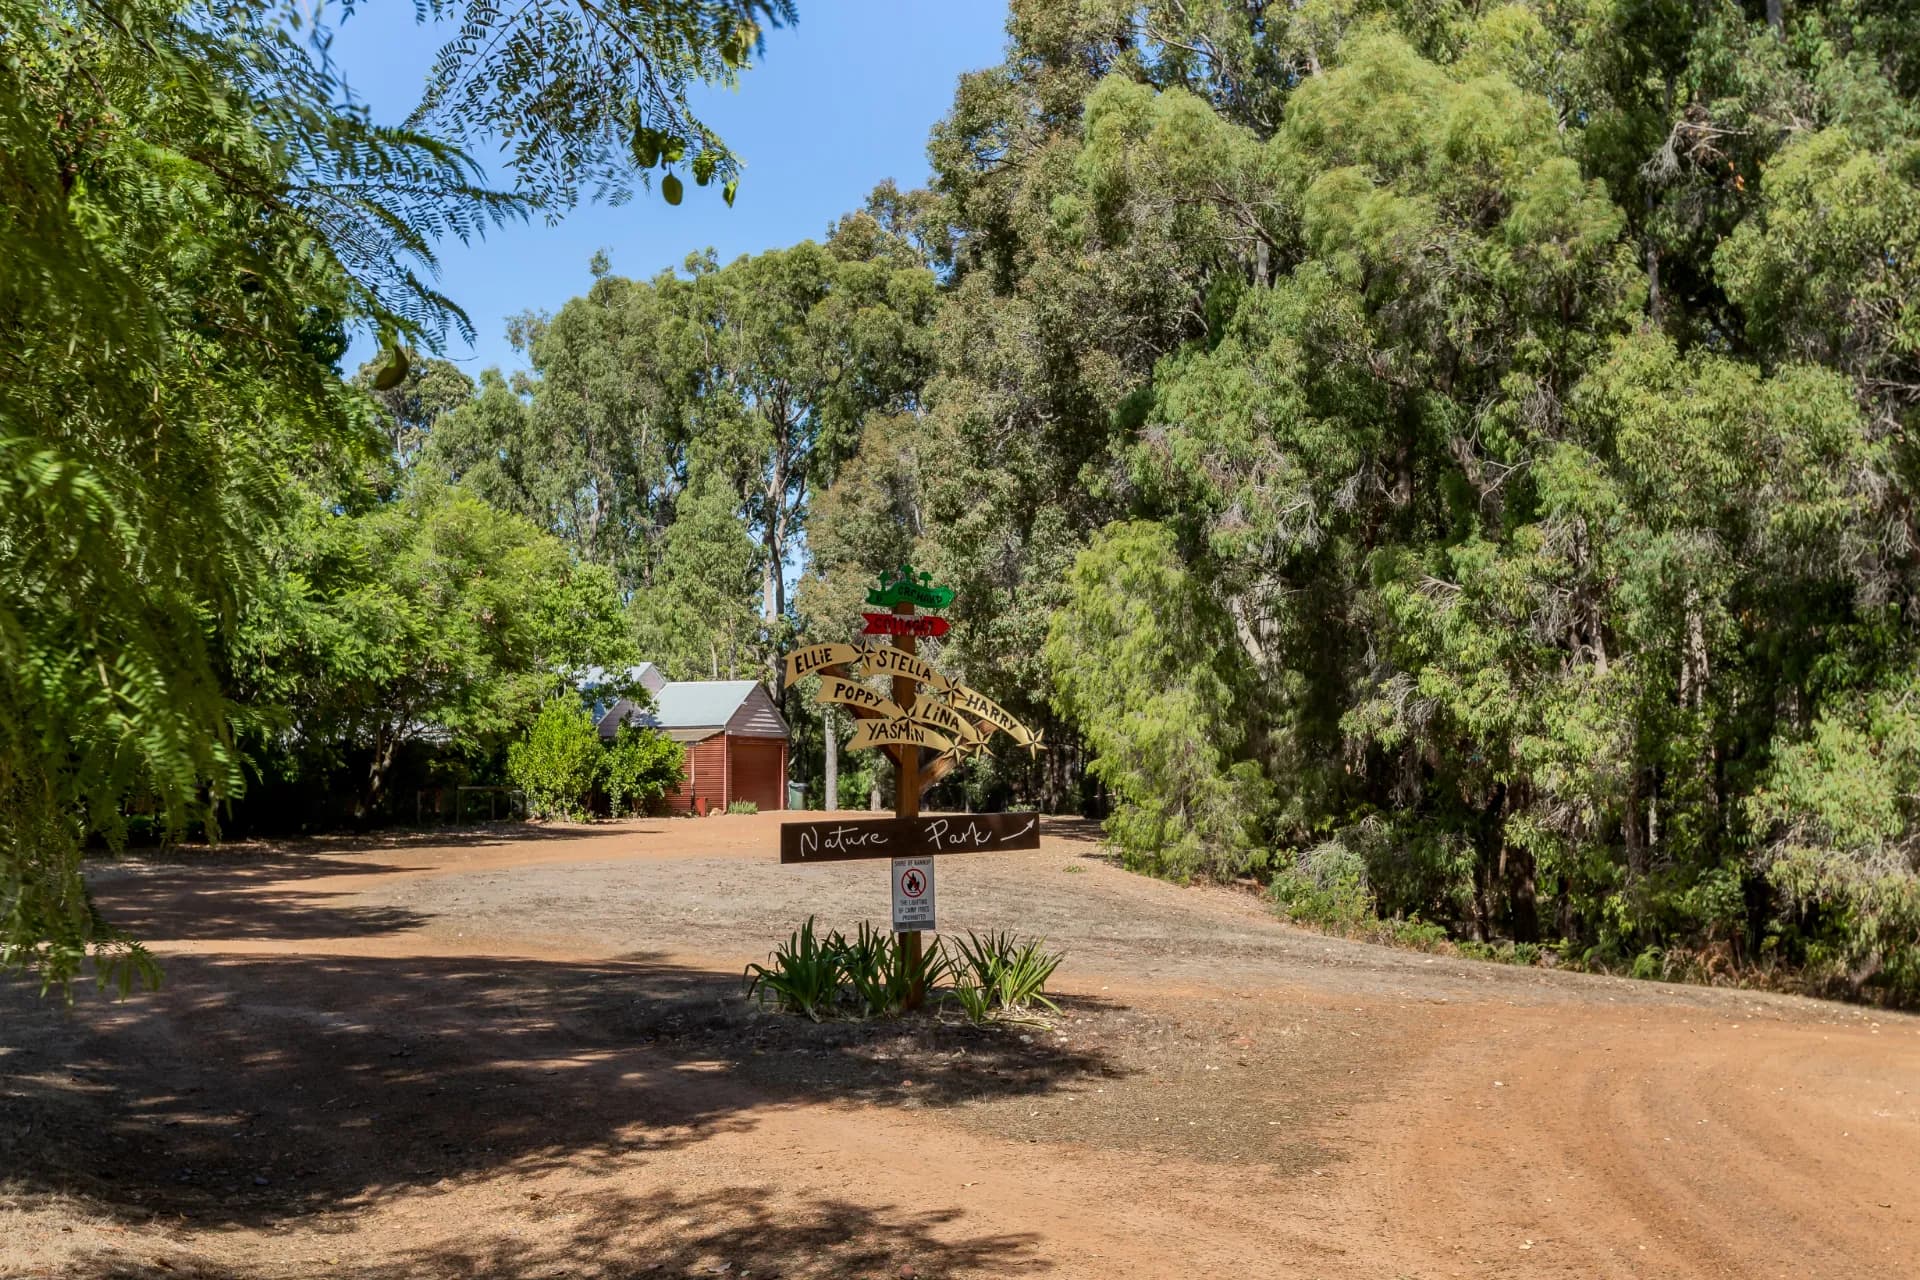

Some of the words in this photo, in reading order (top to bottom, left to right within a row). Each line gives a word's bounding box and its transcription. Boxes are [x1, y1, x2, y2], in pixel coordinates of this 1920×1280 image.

[876, 650, 932, 682] STELLA
[834, 682, 883, 707] POPPY
[966, 694, 1018, 730] HARRY
[800, 826, 889, 857] Nature
[924, 819, 992, 851] Park
